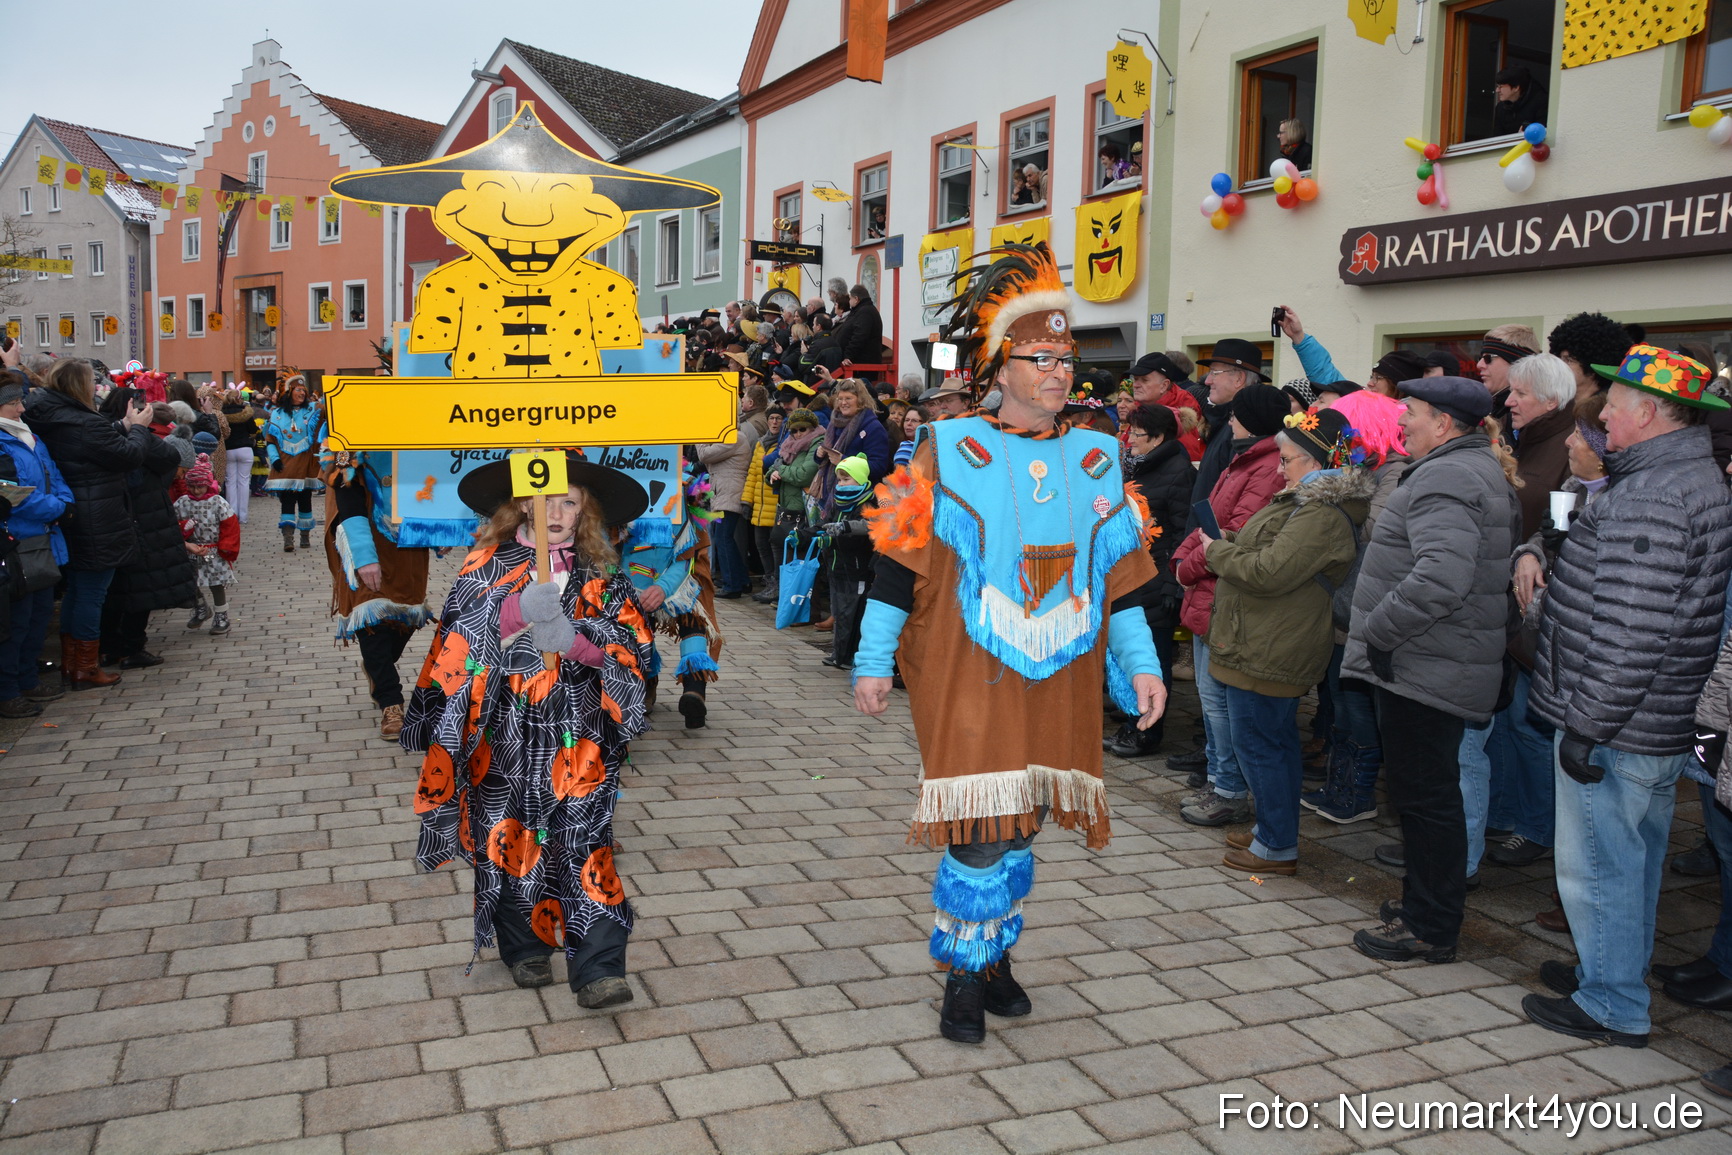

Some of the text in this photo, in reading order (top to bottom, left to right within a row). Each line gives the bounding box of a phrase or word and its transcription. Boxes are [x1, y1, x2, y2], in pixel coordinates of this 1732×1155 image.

[757, 243, 816, 256] RÖHLICH
[1383, 216, 1541, 269] RATHAUS
[1152, 314, 1162, 323] 20
[129, 303, 137, 360] SCHMUCK
[245, 354, 277, 366] GÖTZ
[448, 403, 617, 427] Angergruppe
[527, 458, 550, 489] 9
